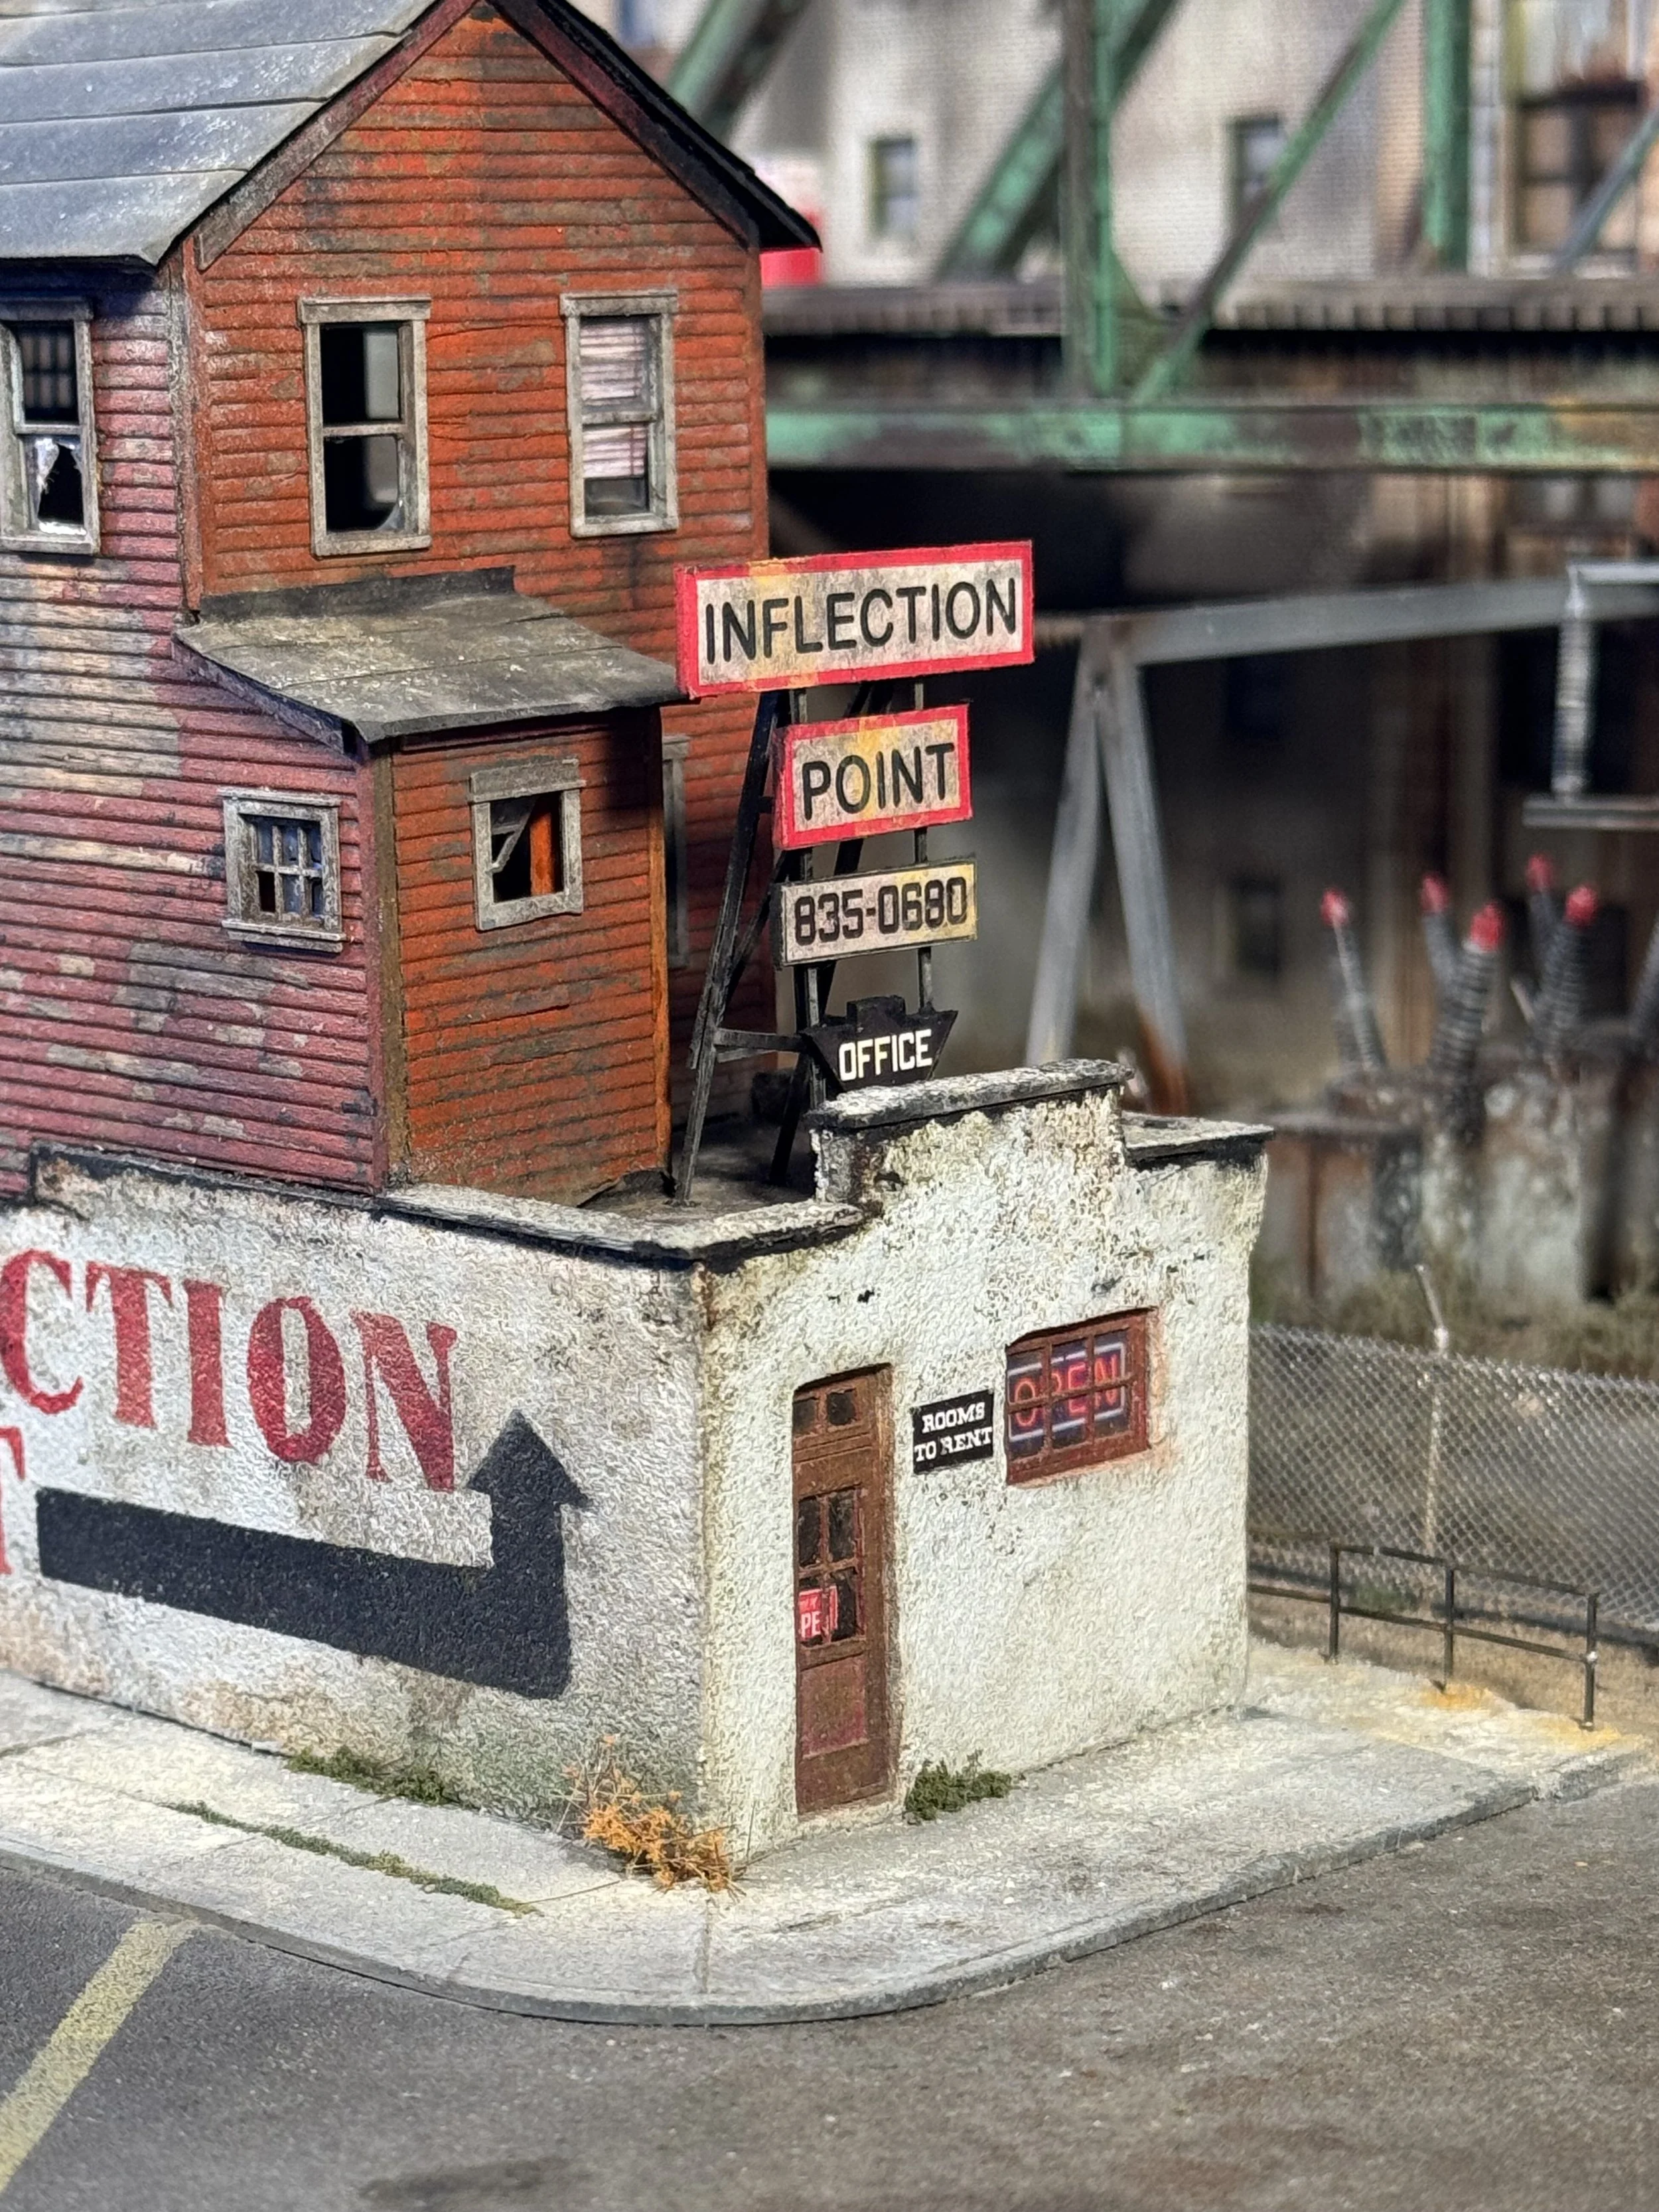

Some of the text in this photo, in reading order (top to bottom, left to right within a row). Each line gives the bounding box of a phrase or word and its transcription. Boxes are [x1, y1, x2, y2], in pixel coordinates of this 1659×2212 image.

[705, 577, 1017, 664] INFLECTION
[802, 743, 955, 820] POINT
[795, 877, 968, 946] 835-0680
[839, 1029, 932, 1082] OFFICE
[914, 1426, 993, 1462] TO RENT
[922, 1402, 985, 1434] ROOMS
